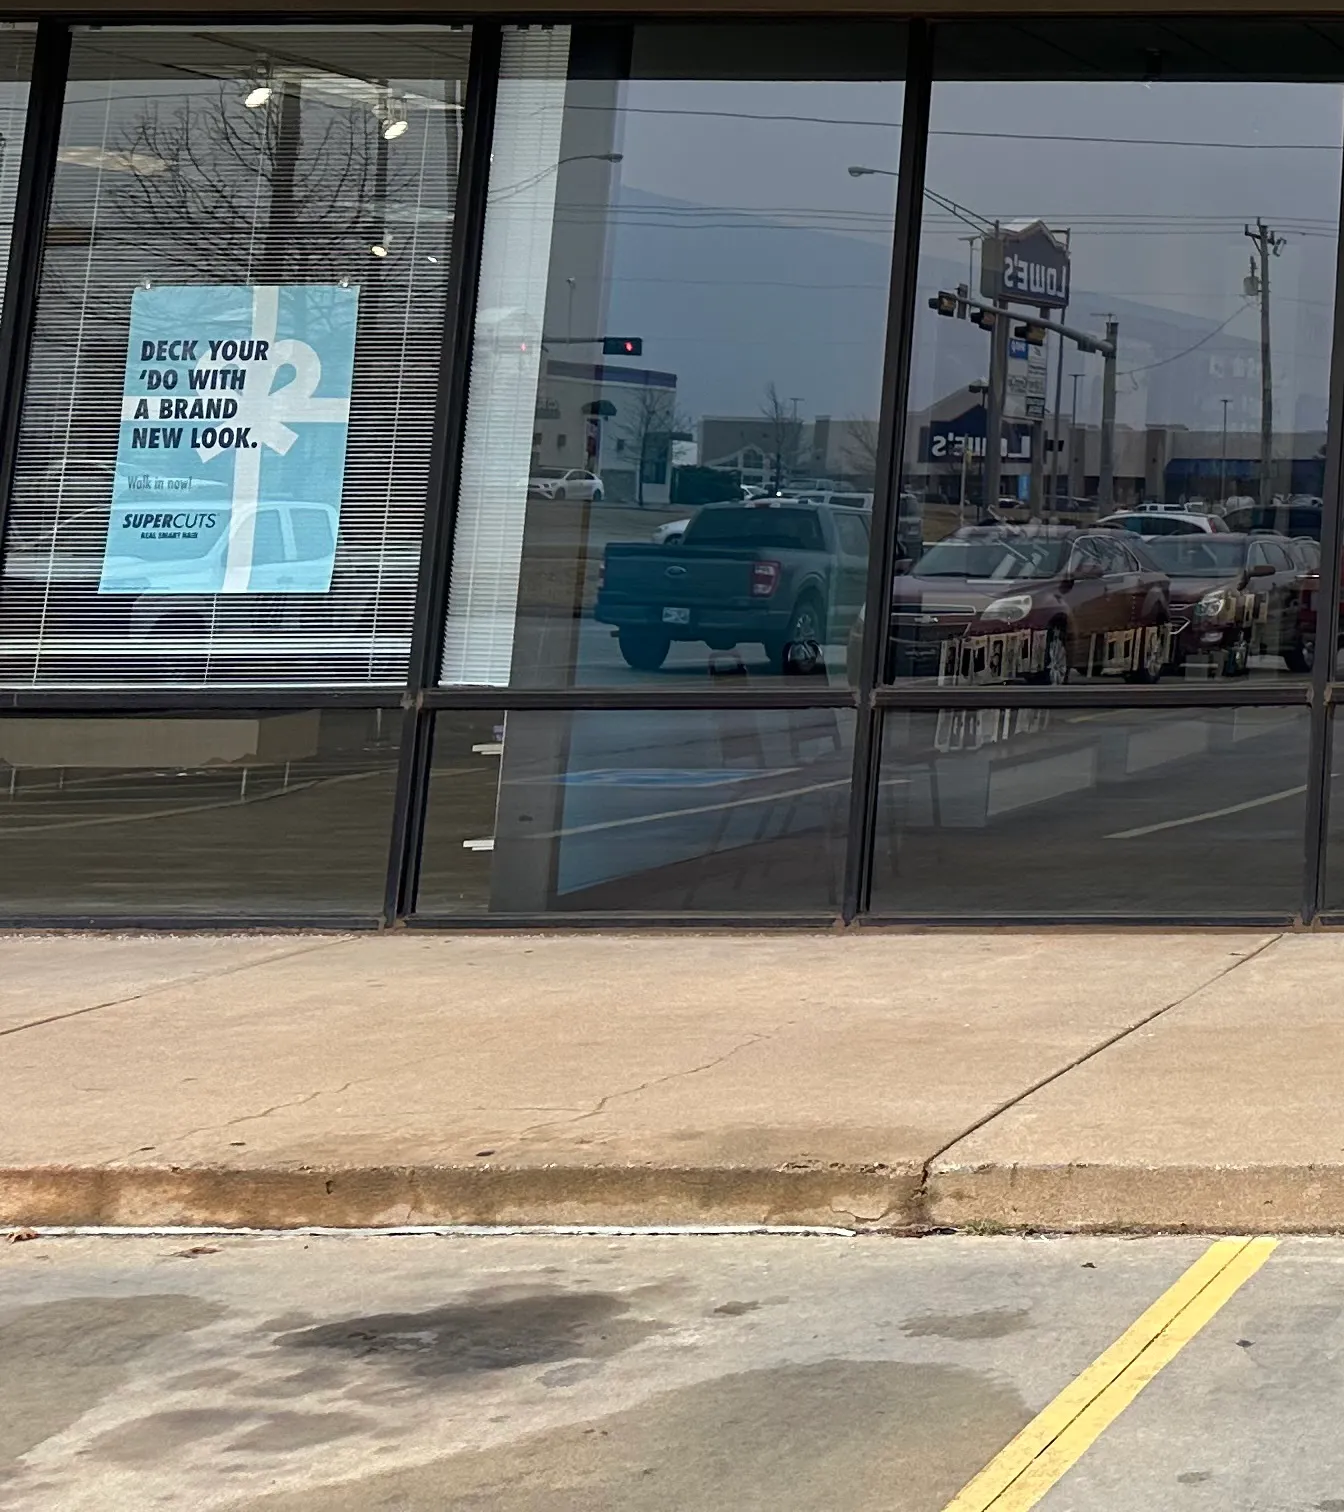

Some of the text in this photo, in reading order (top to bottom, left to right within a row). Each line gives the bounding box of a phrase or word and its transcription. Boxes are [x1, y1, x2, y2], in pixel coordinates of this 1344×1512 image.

[140, 340, 269, 361] DECK YOUR
[139, 369, 247, 390] 'DO WITH
[133, 398, 238, 419] A BRAND
[131, 427, 258, 448] NEW LOOK.
[127, 475, 193, 490] Walk in now!
[122, 513, 216, 529] SUPERCUTS
